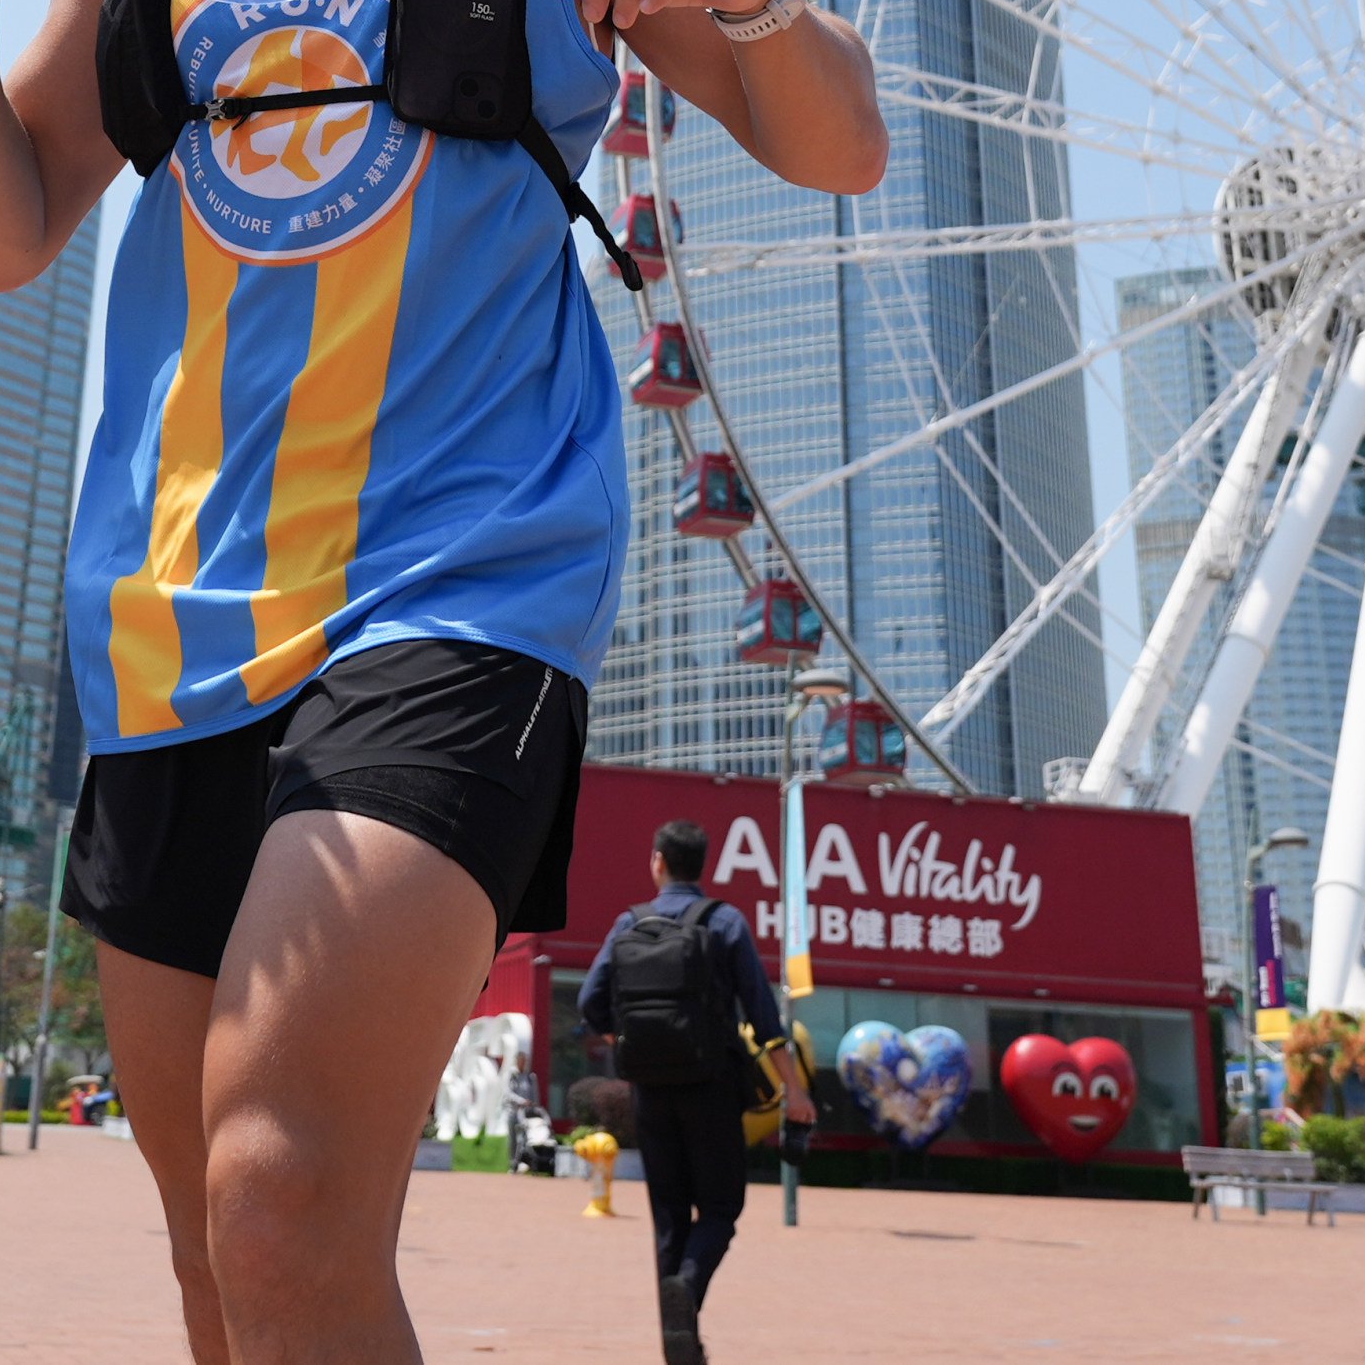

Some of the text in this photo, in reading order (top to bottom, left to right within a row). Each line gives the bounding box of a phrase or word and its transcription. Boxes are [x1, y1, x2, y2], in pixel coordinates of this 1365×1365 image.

[188, 129, 205, 183] UNITE
[206, 189, 272, 234] NURTURE
[288, 117, 407, 234] 重建力量 凝聚社區
[515, 701, 541, 761] ALPHALETE
[712, 815, 868, 895] AA
[877, 820, 1043, 932] Vitality
[849, 907, 1004, 958] 健康總部
